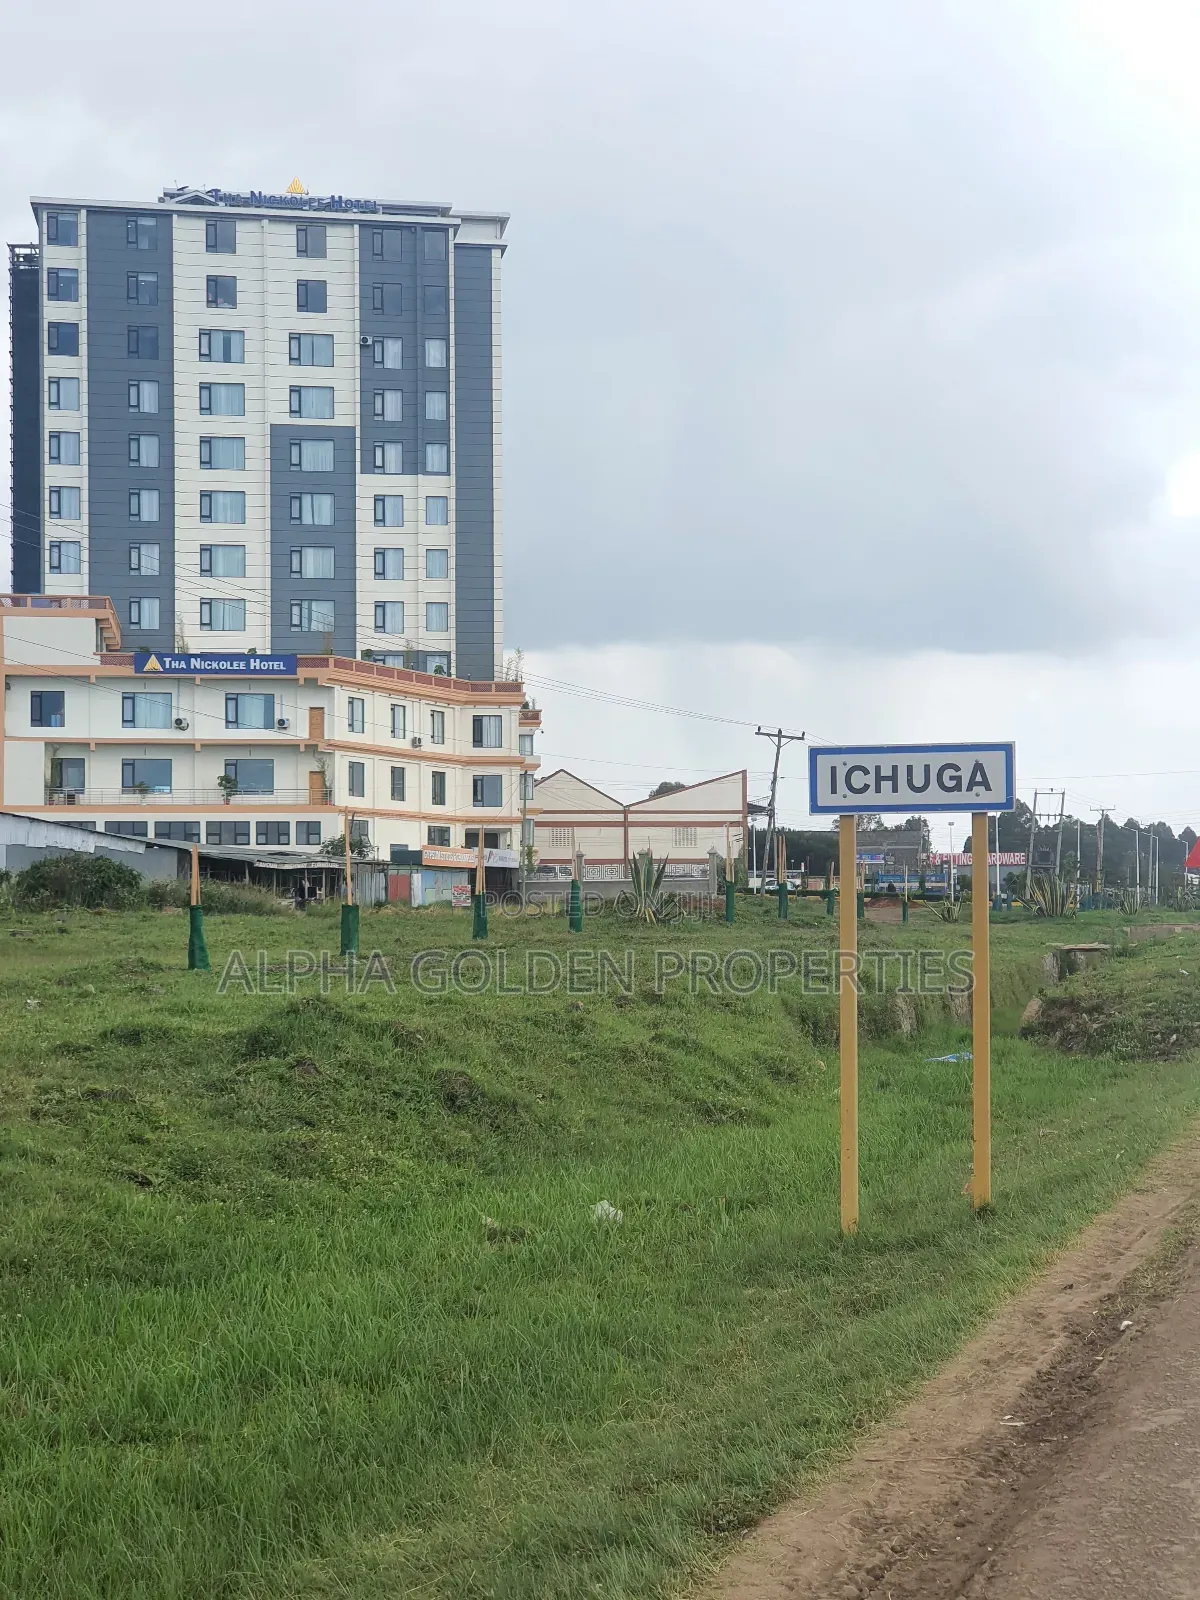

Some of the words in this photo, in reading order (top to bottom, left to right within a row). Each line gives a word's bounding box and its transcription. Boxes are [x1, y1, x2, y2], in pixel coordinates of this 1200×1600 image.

[163, 657, 187, 669] THA
[190, 657, 246, 670] NICKOLEE
[250, 658, 287, 670] HOTEL
[830, 762, 993, 795] ICHUGA
